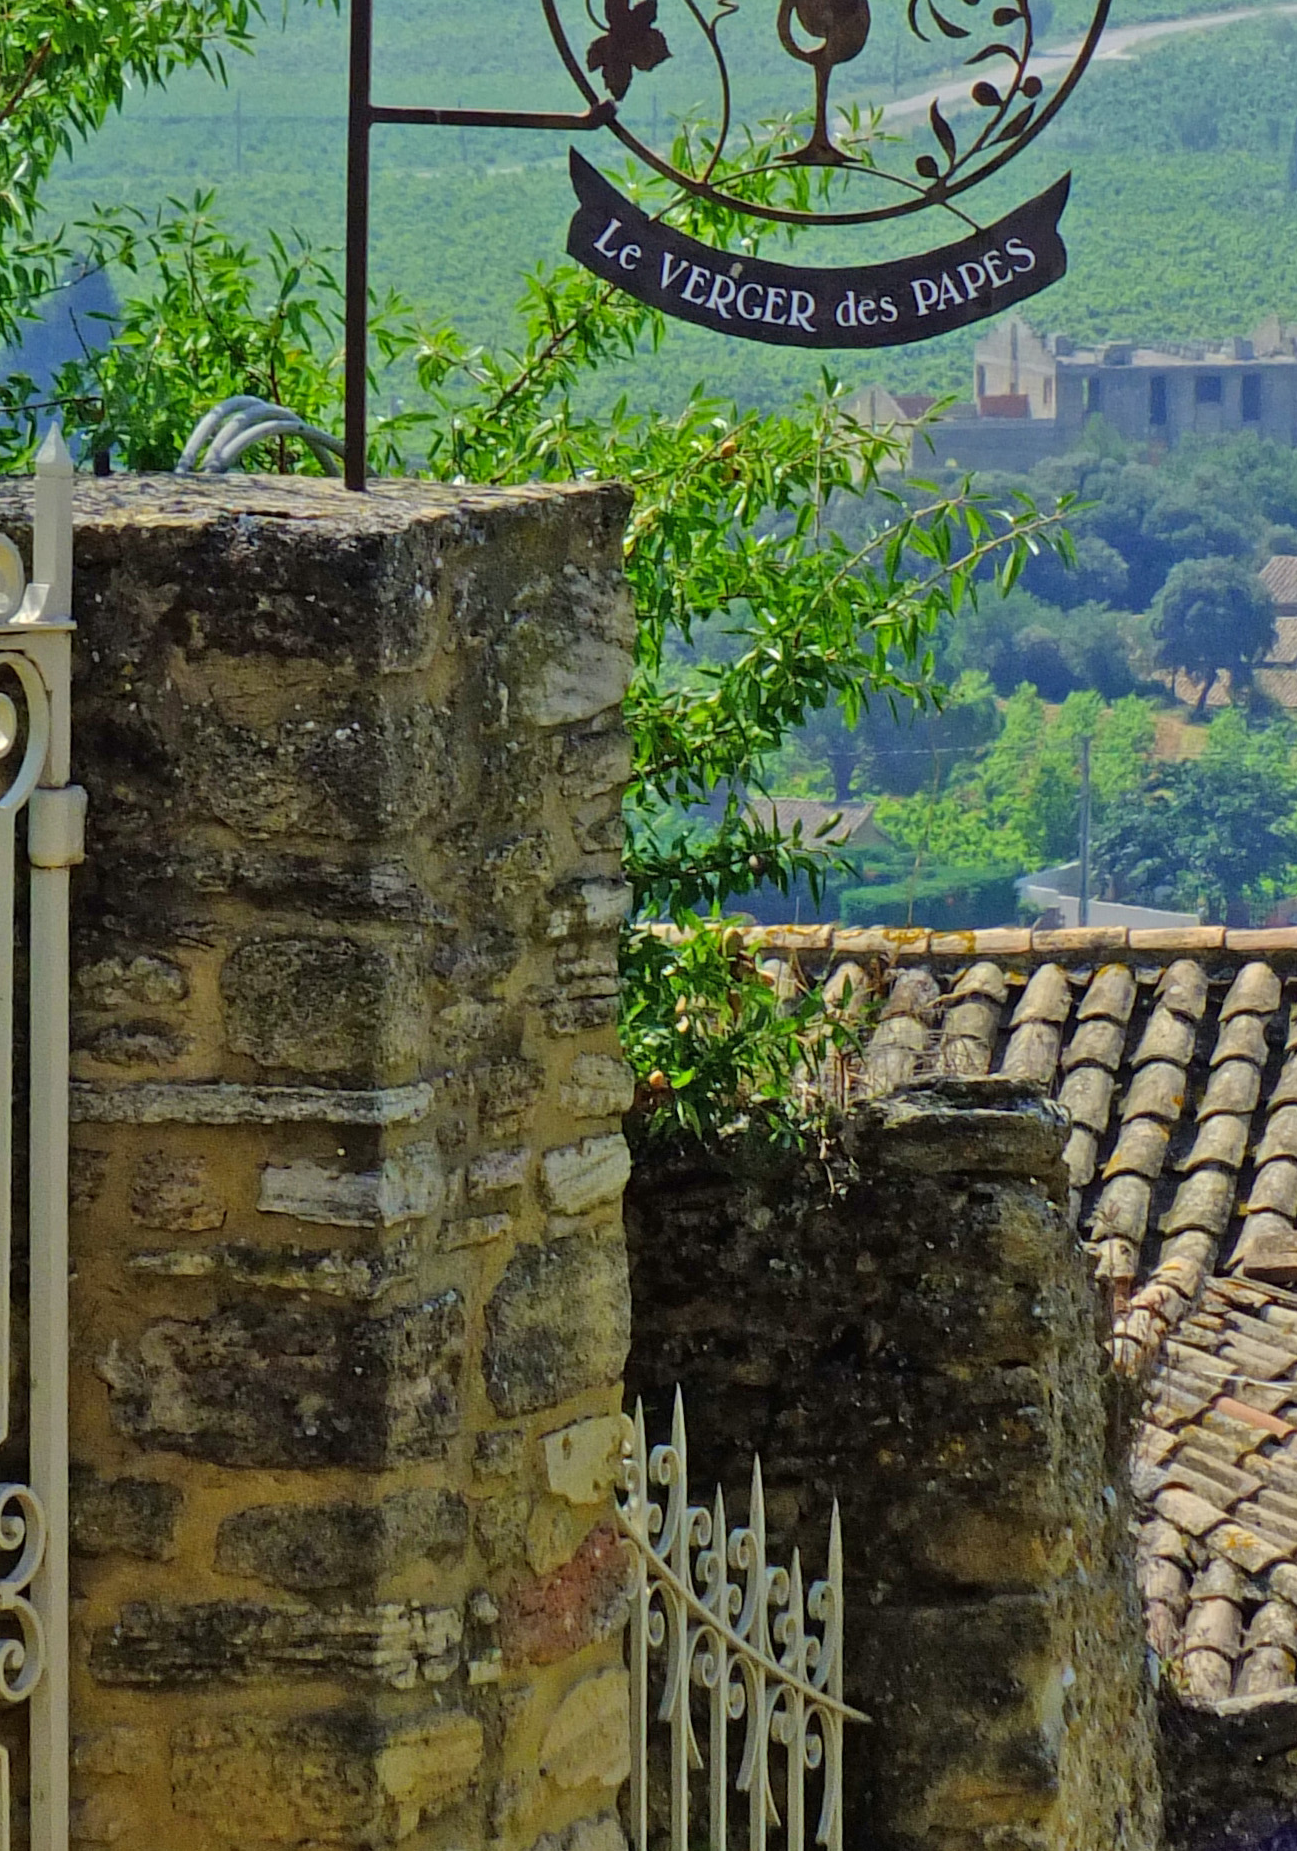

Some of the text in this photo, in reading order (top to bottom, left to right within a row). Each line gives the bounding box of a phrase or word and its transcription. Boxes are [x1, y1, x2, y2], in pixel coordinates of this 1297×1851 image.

[592, 218, 1037, 332] Le VERGER des PAPES
